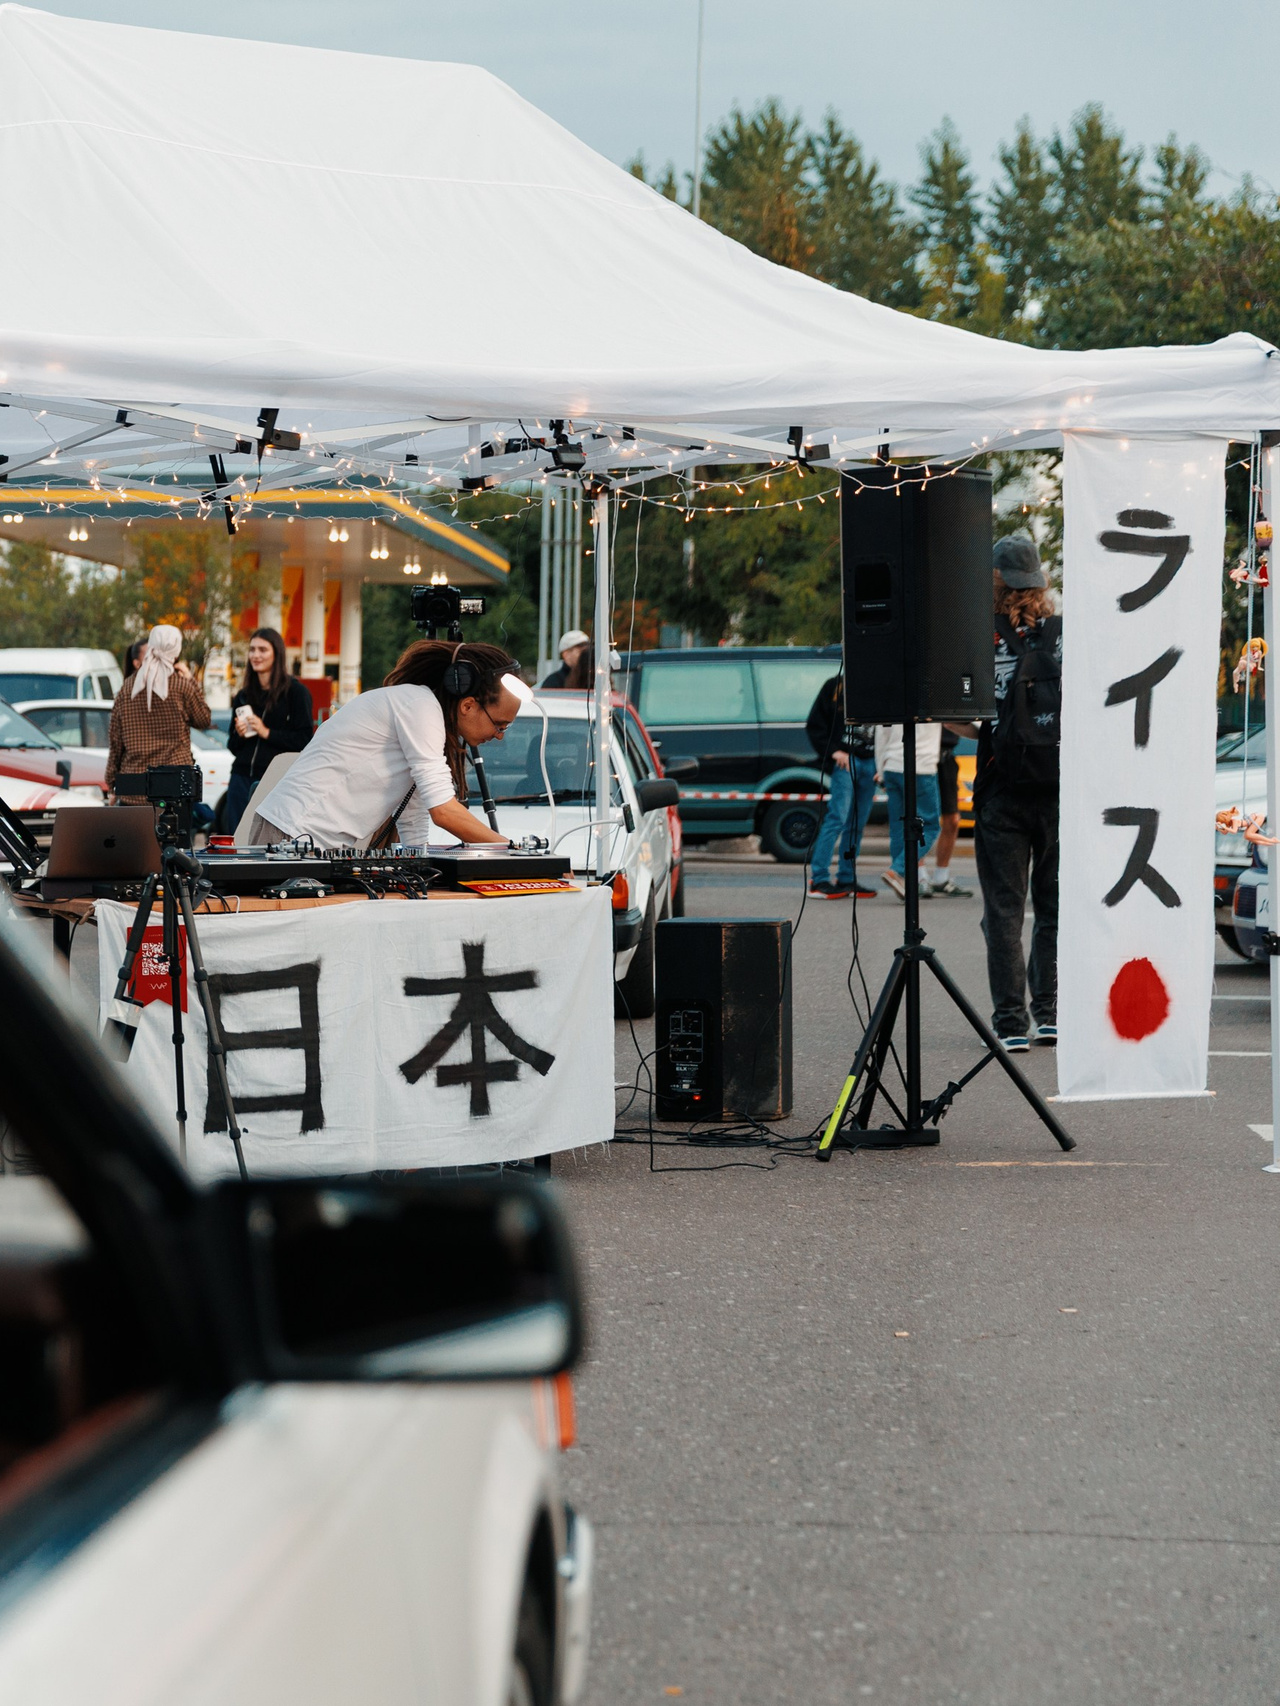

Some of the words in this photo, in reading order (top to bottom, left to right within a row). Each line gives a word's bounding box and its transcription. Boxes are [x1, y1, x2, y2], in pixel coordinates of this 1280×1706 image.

[1097, 508, 1193, 908] ライス
[204, 939, 556, 1134] 日本
